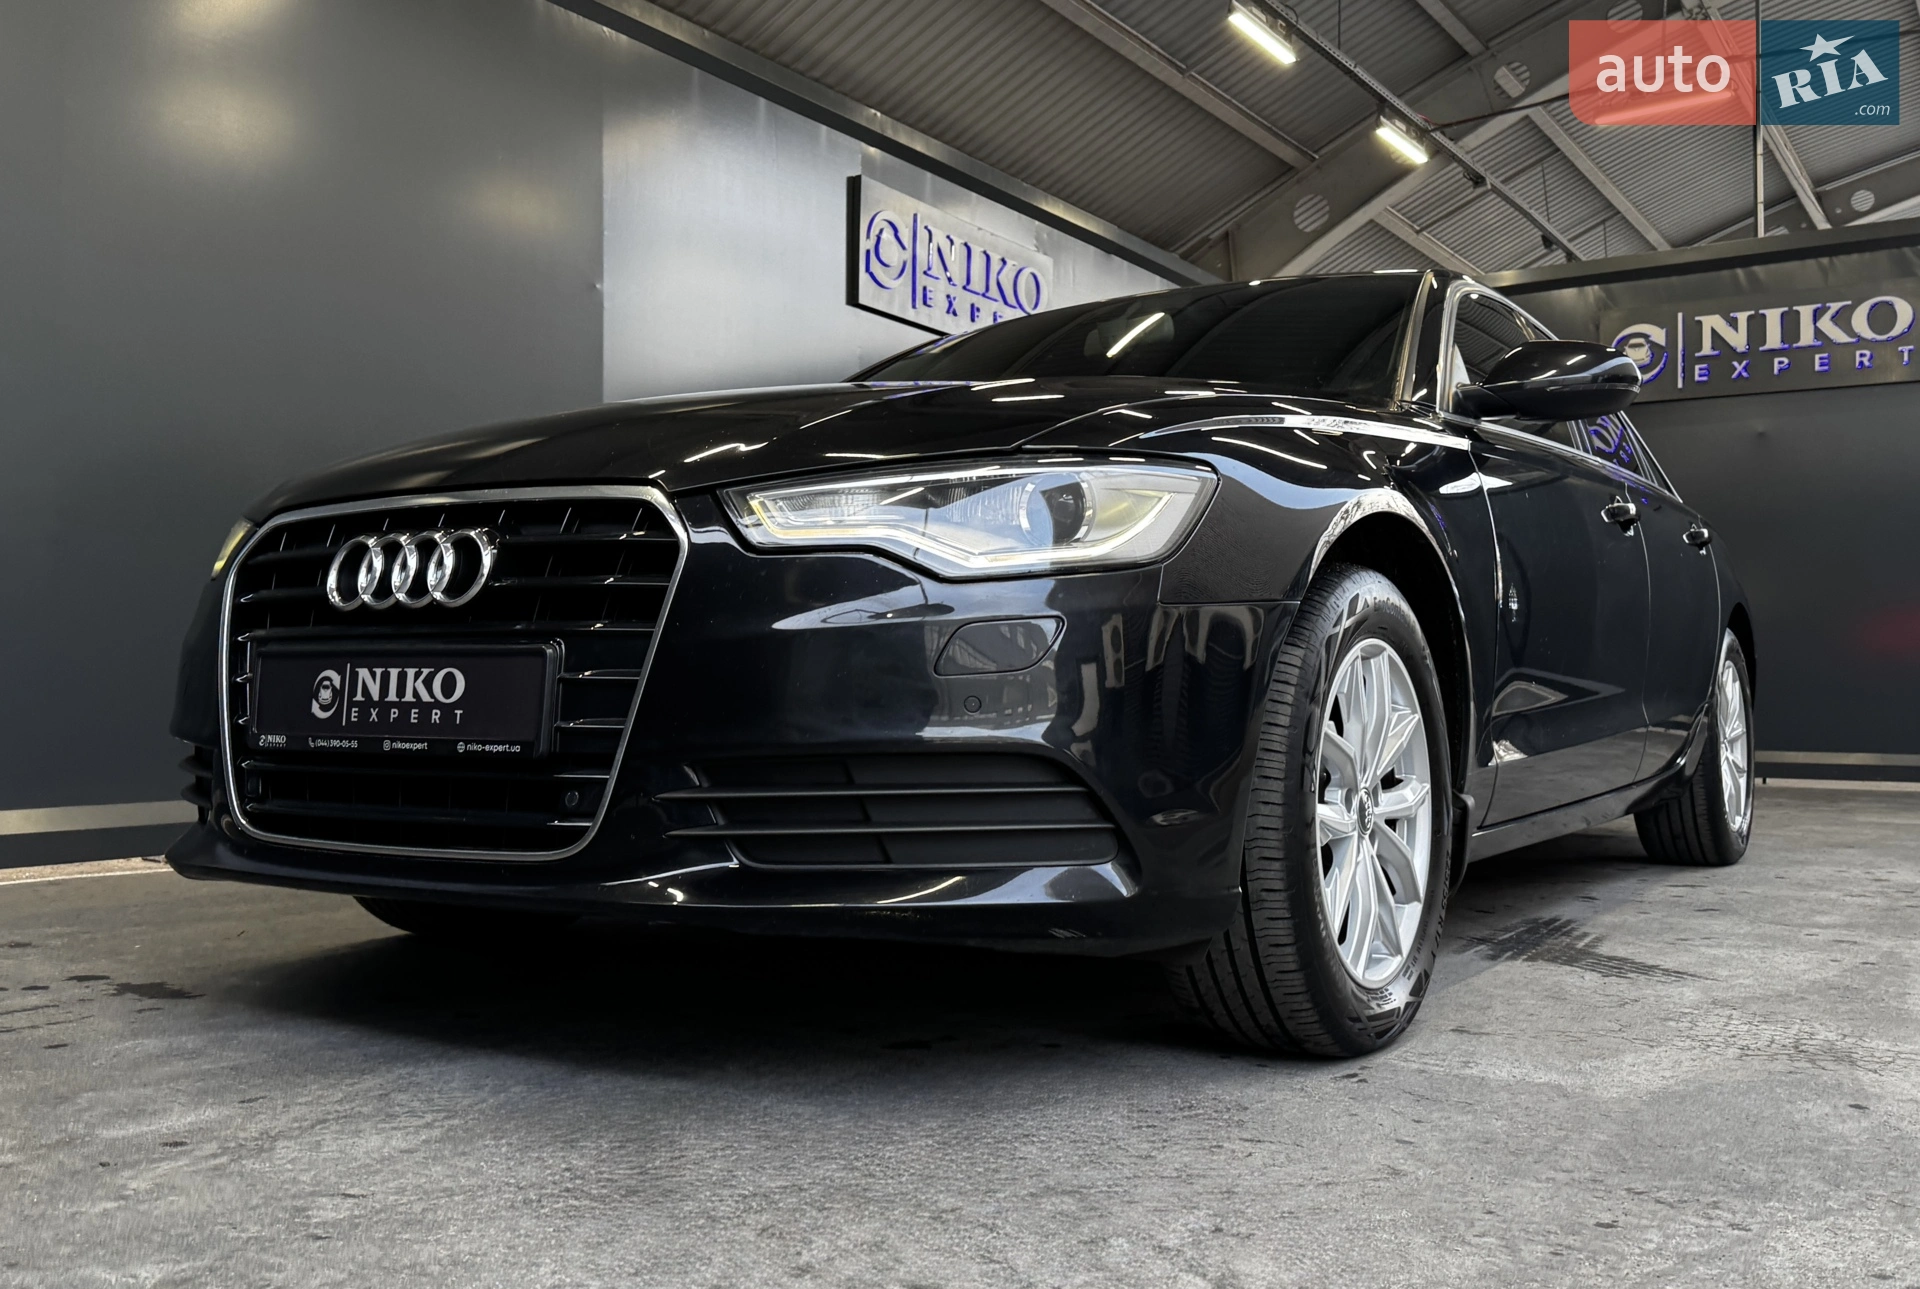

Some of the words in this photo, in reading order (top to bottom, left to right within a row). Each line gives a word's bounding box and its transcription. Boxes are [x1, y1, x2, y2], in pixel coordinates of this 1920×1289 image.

[923, 225, 1048, 315] NIKO
[1695, 296, 1915, 357] NIKO
[1695, 345, 1915, 382] EXPERT
[352, 667, 466, 703] NIKO
[351, 707, 463, 724] EXPERT
[267, 734, 286, 744] NIKO
[392, 740, 428, 751] nikoexpert
[466, 742, 521, 753] niko-expert.ua
